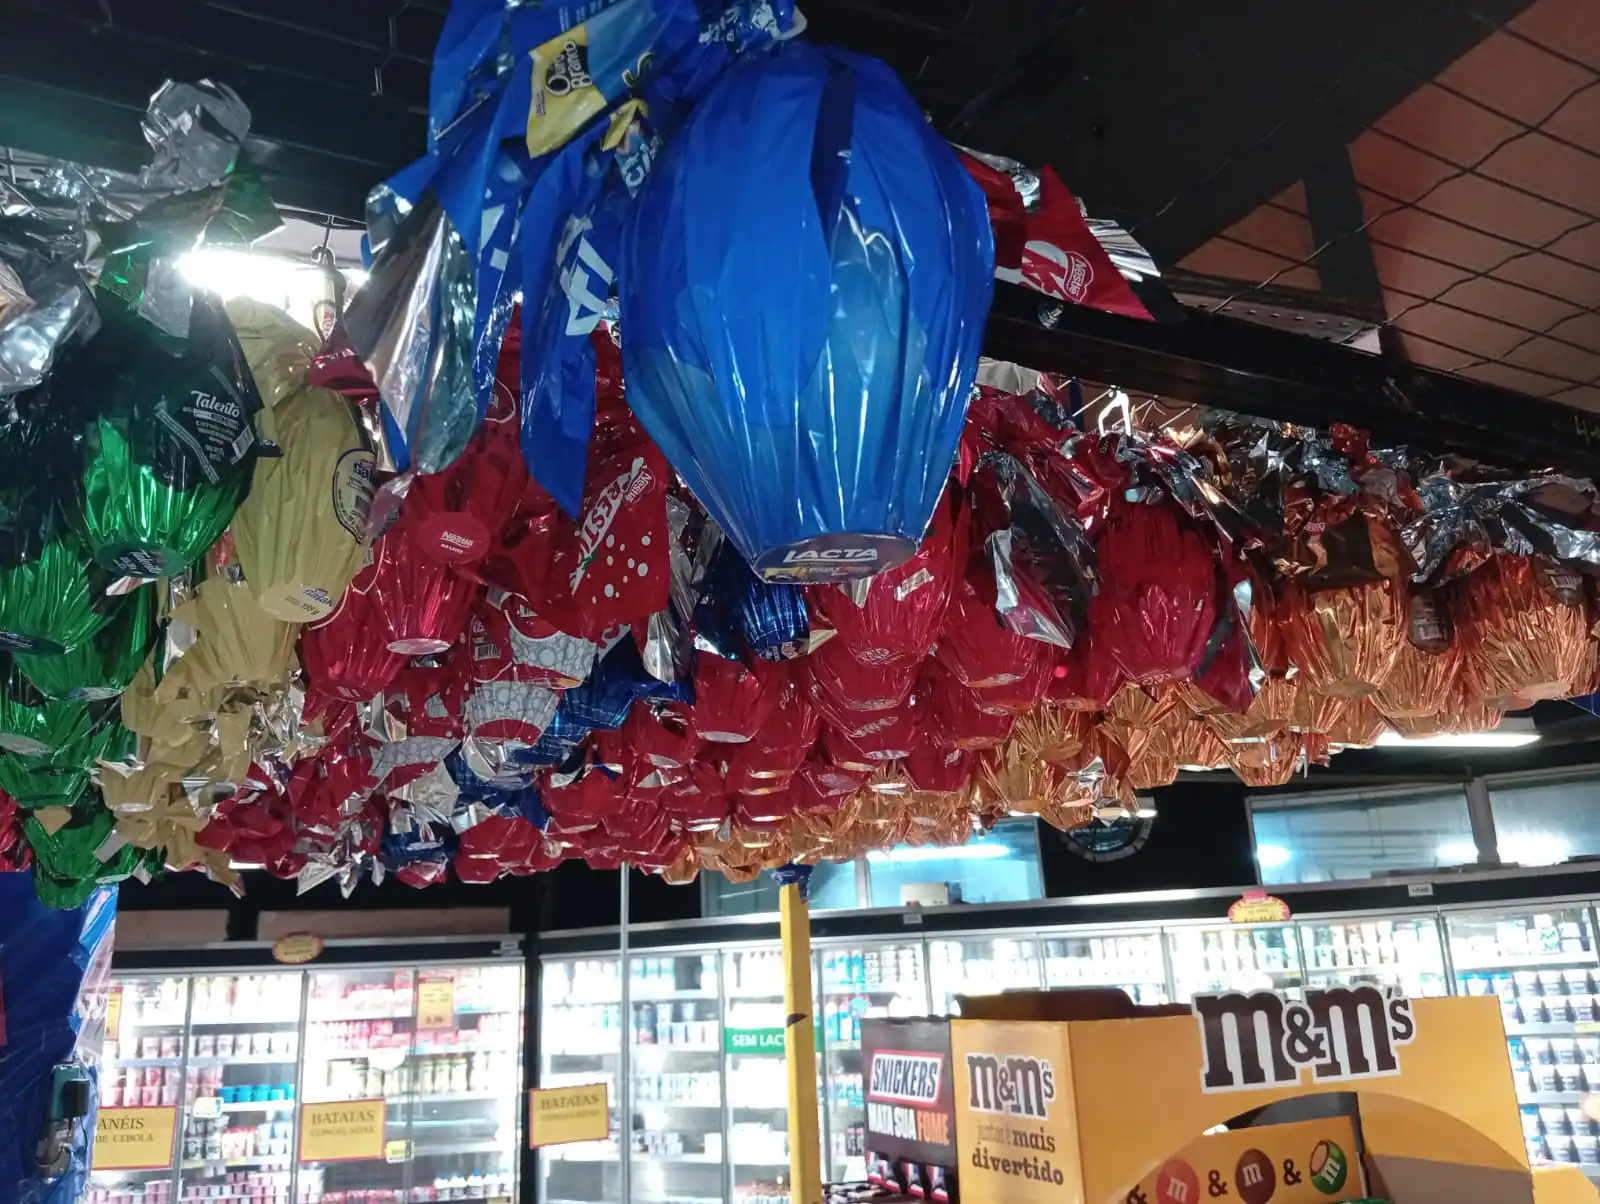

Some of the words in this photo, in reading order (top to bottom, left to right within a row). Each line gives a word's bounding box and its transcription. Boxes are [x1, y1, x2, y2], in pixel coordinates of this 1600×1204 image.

[1068, 257, 1088, 297] Nestlé
[190, 390, 240, 418] Talento
[783, 548, 878, 564] LACTA
[731, 1034, 757, 1047] SEM
[873, 1057, 939, 1098] SNICKERS
[541, 1094, 600, 1111] BATATAS
[97, 1114, 145, 1131] ANÉIS
[311, 1110, 376, 1126] BATATAS
[868, 1102, 894, 1136] MATA
[893, 1106, 918, 1141] SUA
[916, 1110, 950, 1146] FOME
[112, 1132, 154, 1144] CEBOLA
[1011, 1126, 1056, 1153] mais
[971, 1146, 1065, 1186] divertido
[1208, 1169, 1228, 1197] &
[1241, 1161, 1264, 1187] m
[1282, 1158, 1302, 1186] &
